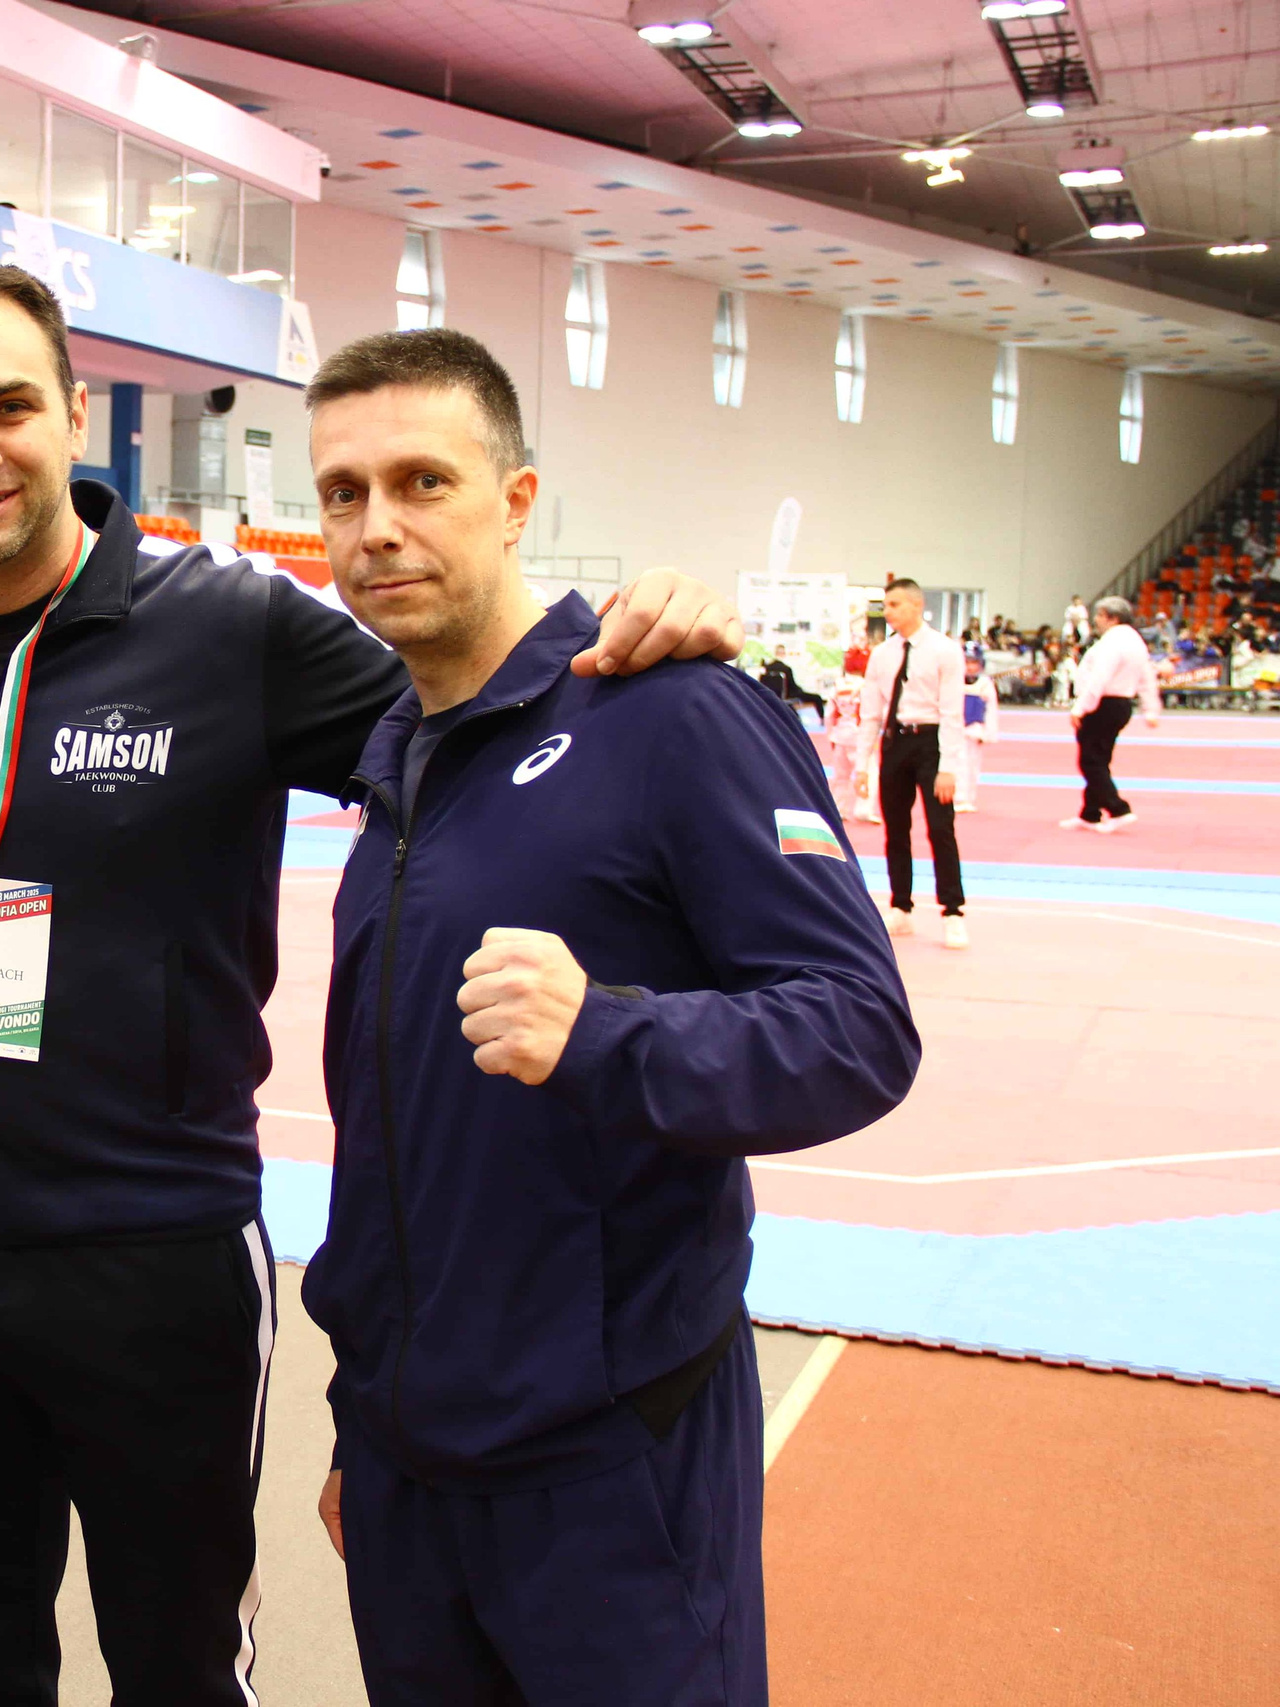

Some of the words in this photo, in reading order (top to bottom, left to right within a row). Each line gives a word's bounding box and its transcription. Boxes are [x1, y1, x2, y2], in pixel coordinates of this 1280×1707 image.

[85, 703, 134, 715] ESTABLISHED
[50, 727, 174, 776] SAMSON
[74, 771, 137, 783] TAEKWONDO
[91, 783, 116, 793] CLUB
[3, 889, 26, 900] MARCH
[26, 888, 39, 897] 2025
[19, 899, 47, 914] OPEN
[7, 1001, 42, 1012] TOURNAMENT
